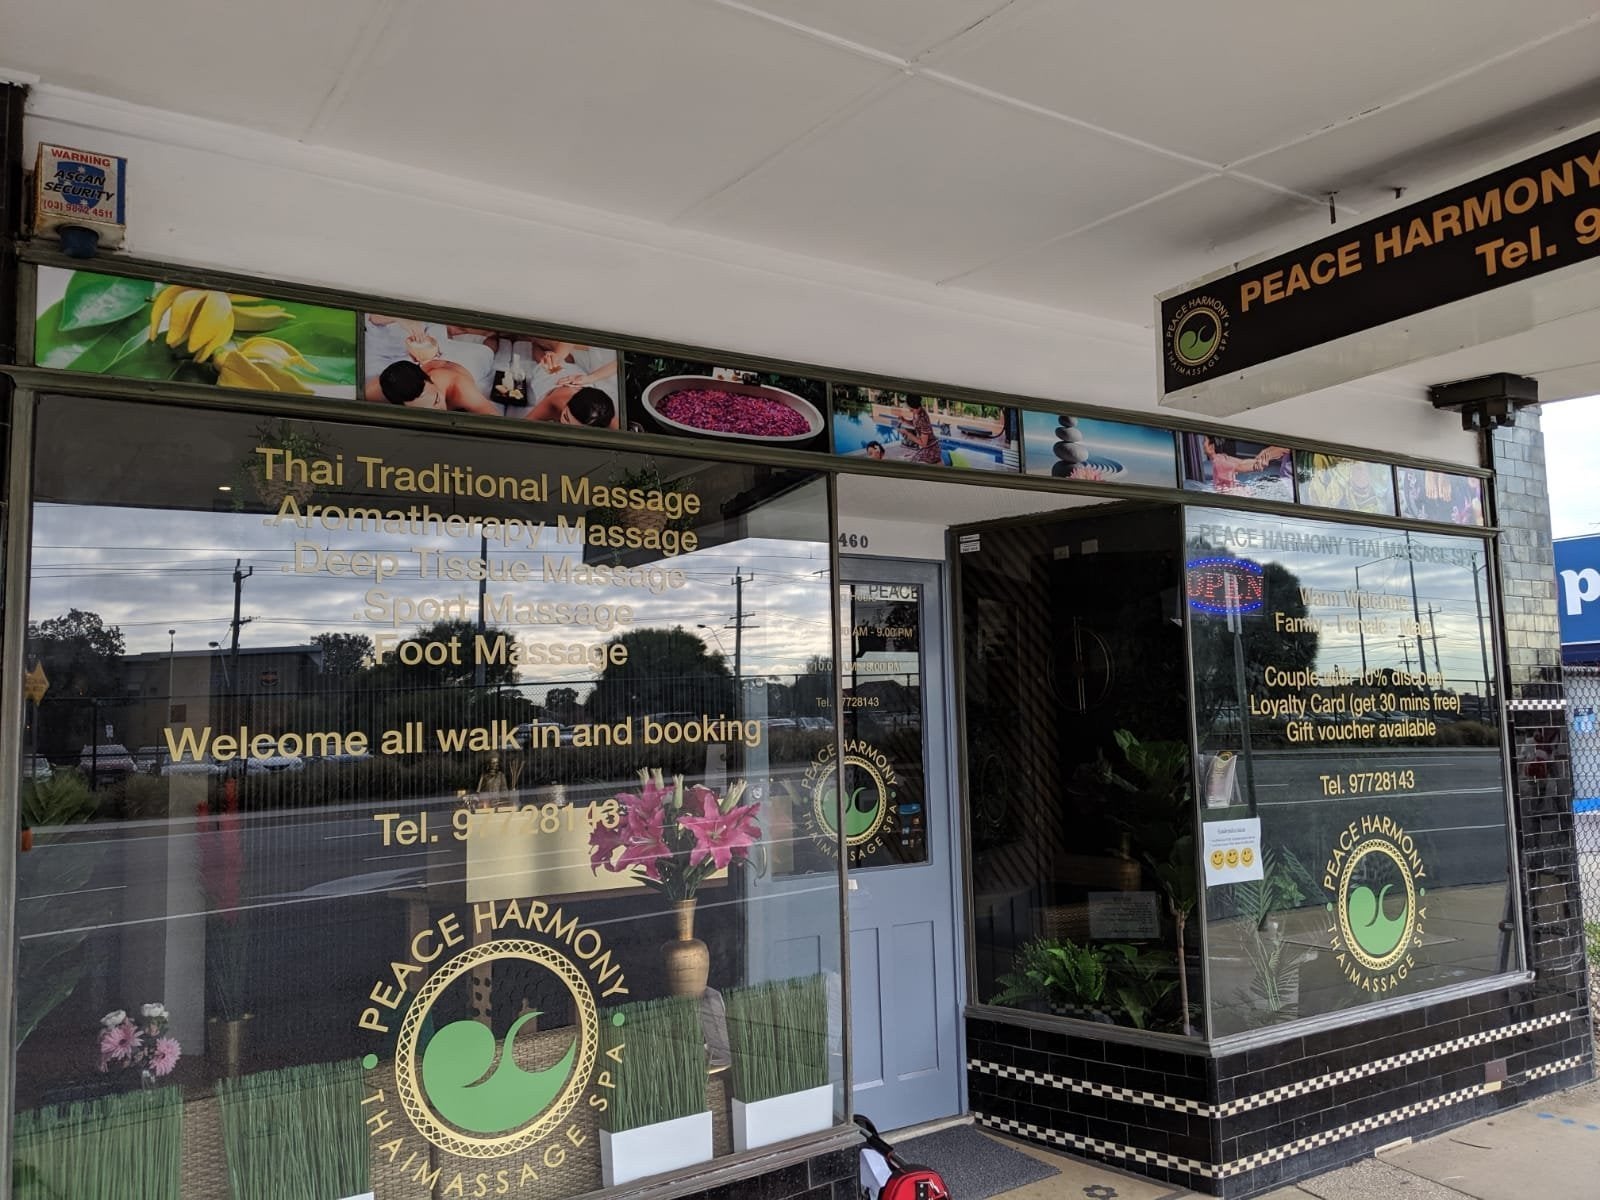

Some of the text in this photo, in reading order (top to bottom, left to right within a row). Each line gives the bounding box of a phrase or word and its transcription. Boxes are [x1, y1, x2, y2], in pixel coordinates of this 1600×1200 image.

[51, 148, 111, 168] WARNING
[43, 181, 116, 202] SECURITY
[53, 169, 107, 187] ASCAN
[92, 207, 114, 219] 4511
[1240, 149, 1600, 313] PEACE HARMONY
[1475, 225, 1558, 277] Tel.
[1166, 295, 1230, 338] PEACE HARMONY
[255, 447, 701, 520] Thai Traditional Massage
[557, 514, 699, 557] Massage
[838, 532, 869, 549] 460
[1199, 523, 1258, 549] PEACE
[1262, 529, 1342, 555] HARMONY
[1345, 536, 1380, 558] THAI
[411, 545, 532, 584] Tissue
[542, 553, 687, 595] Massage
[1187, 570, 1264, 600] OPEN
[484, 593, 634, 632] Massage
[1299, 587, 1340, 607] Warm
[474, 634, 629, 672] Massage
[1264, 666, 1320, 692] Couple
[1358, 668, 1388, 687] 10%
[815, 697, 880, 708] Tel. 7728143
[1251, 689, 1461, 719] Loyalty Card (get 30 mins free)
[163, 713, 762, 763] Welcome all walk in and booking
[1286, 716, 1437, 743] Gift voucher available
[801, 743, 837, 790] PEACE
[1319, 770, 1415, 796] Tel. 97728143
[374, 798, 620, 846] Tel. 97728143
[882, 804, 898, 834] SPA
[1324, 814, 1426, 892] PEACE HARMONY
[1413, 905, 1428, 949] SPA
[358, 898, 630, 1033] PEACE HARMONY
[589, 1043, 626, 1112] SPA
